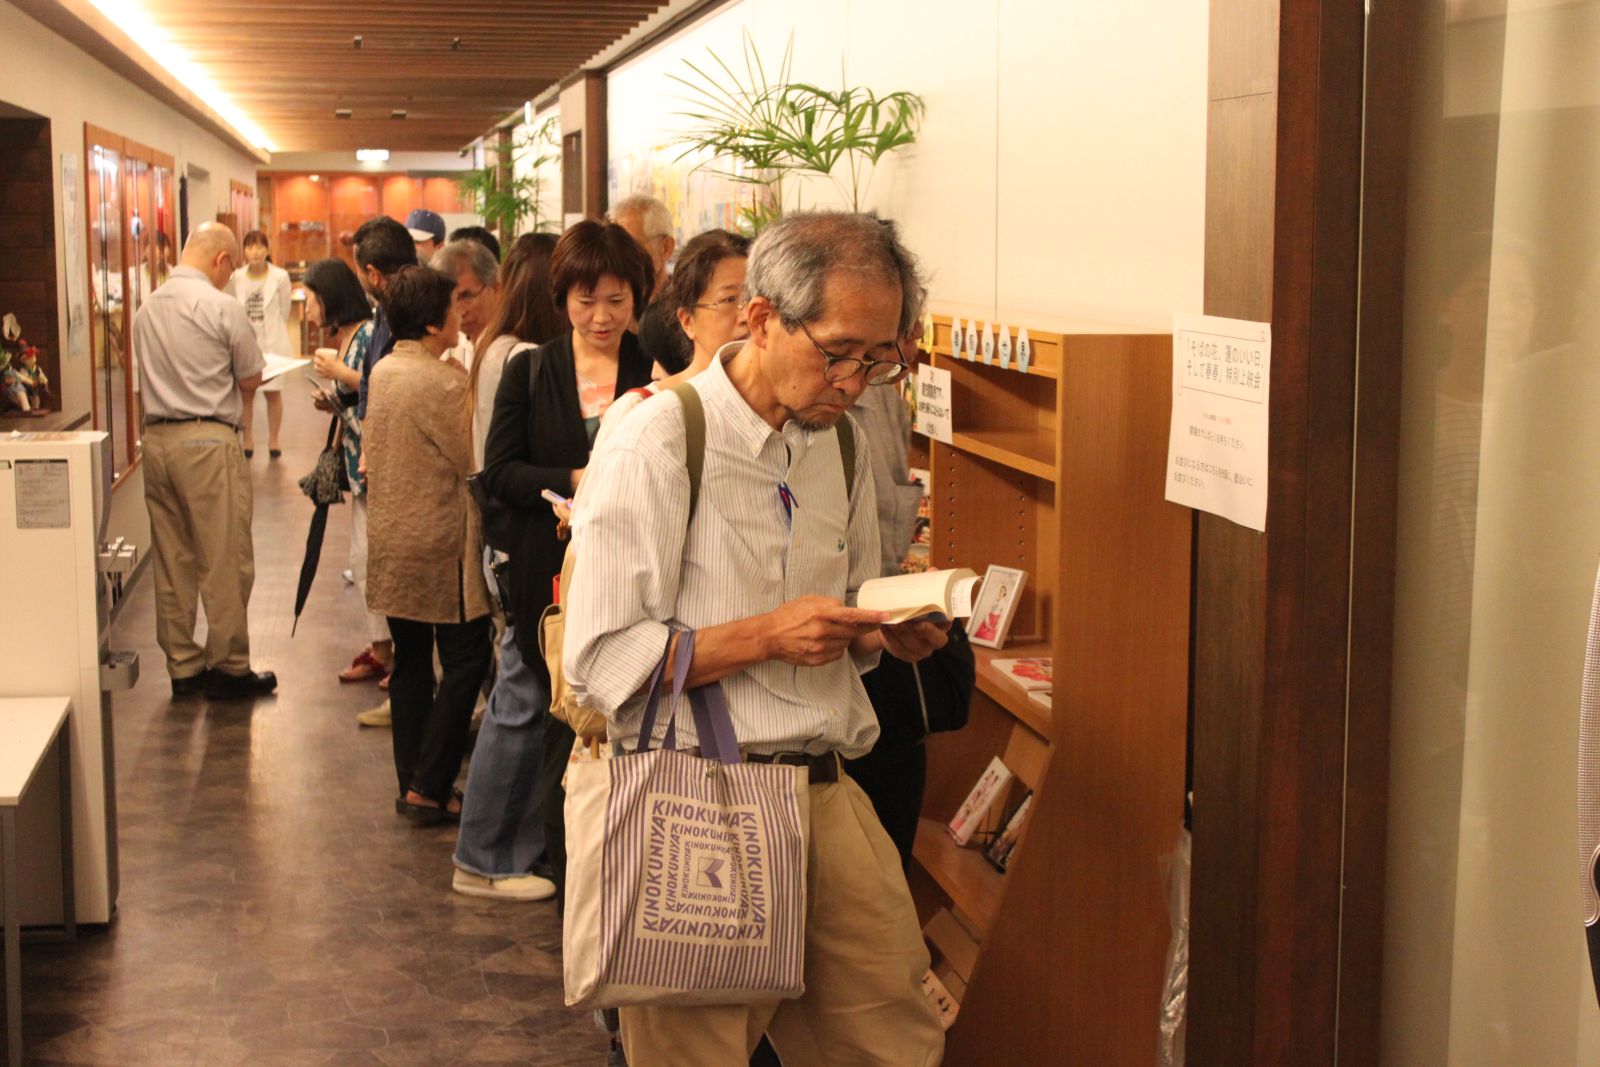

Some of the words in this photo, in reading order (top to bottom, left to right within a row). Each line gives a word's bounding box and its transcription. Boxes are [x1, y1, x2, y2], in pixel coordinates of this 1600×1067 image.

[652, 799, 741, 829] KINOKUNA
[643, 816, 666, 932] KINOKUNIYA
[665, 832, 681, 912] KINOKUNIYA
[681, 846, 692, 898] KINOKUNIYA
[741, 811, 766, 924] KINOKUNIYA
[676, 901, 748, 920] KINOKUNIYA
[688, 891, 736, 904] KINOKUNIYA
[659, 916, 766, 941] KINOKUNIYA
